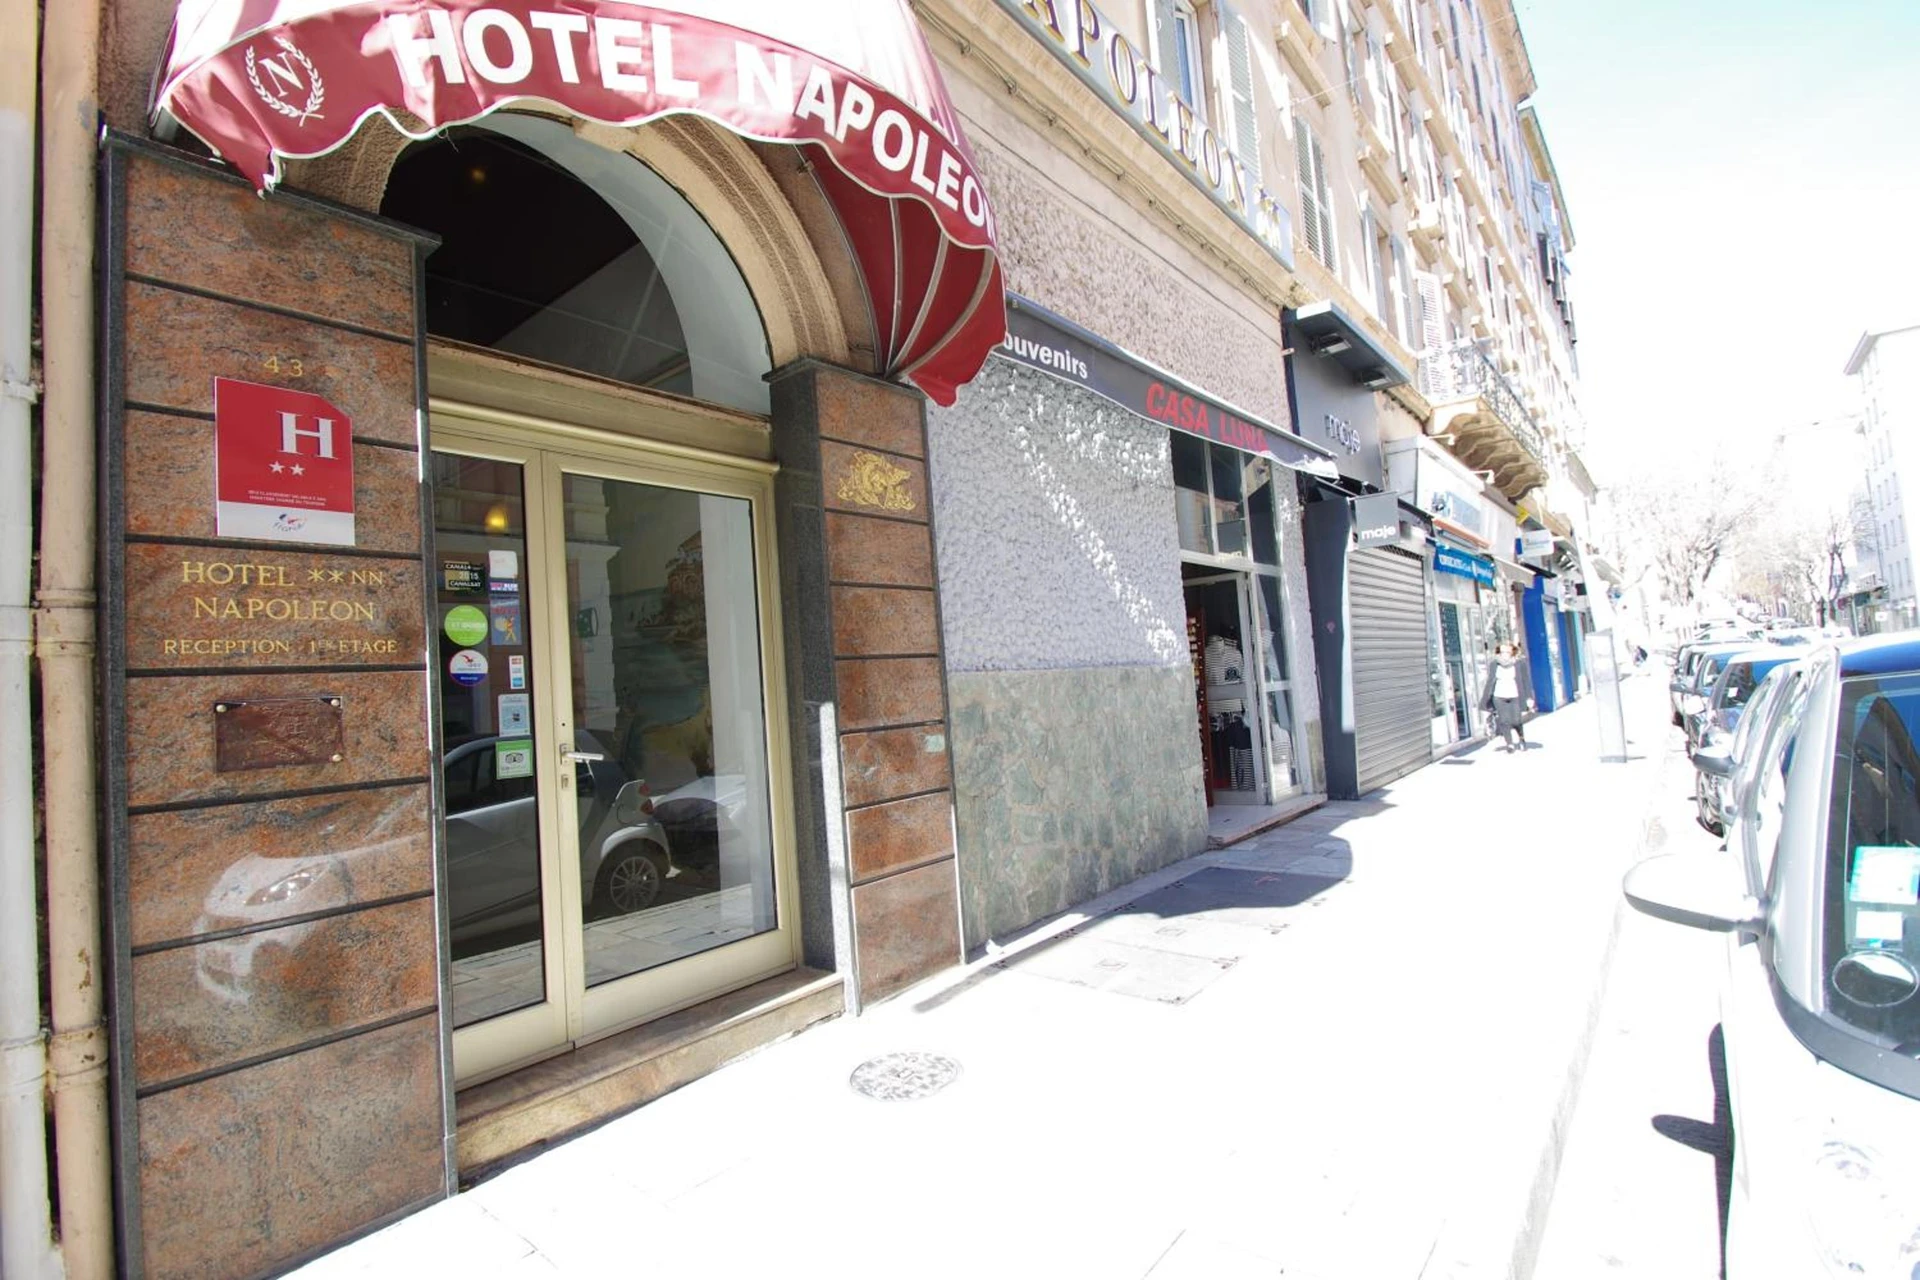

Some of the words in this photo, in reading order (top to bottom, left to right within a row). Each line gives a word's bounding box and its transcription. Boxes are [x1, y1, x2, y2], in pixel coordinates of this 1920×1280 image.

[389, 8, 700, 99] HOTEL
[263, 356, 303, 377] 43
[1146, 382, 1211, 438] CASA
[276, 410, 338, 460] H
[182, 561, 295, 587] HOTEL
[352, 570, 384, 585] NN
[194, 597, 374, 621] NAPOLEON
[164, 639, 291, 654] RECEPTION
[339, 640, 398, 653] ETAGE
